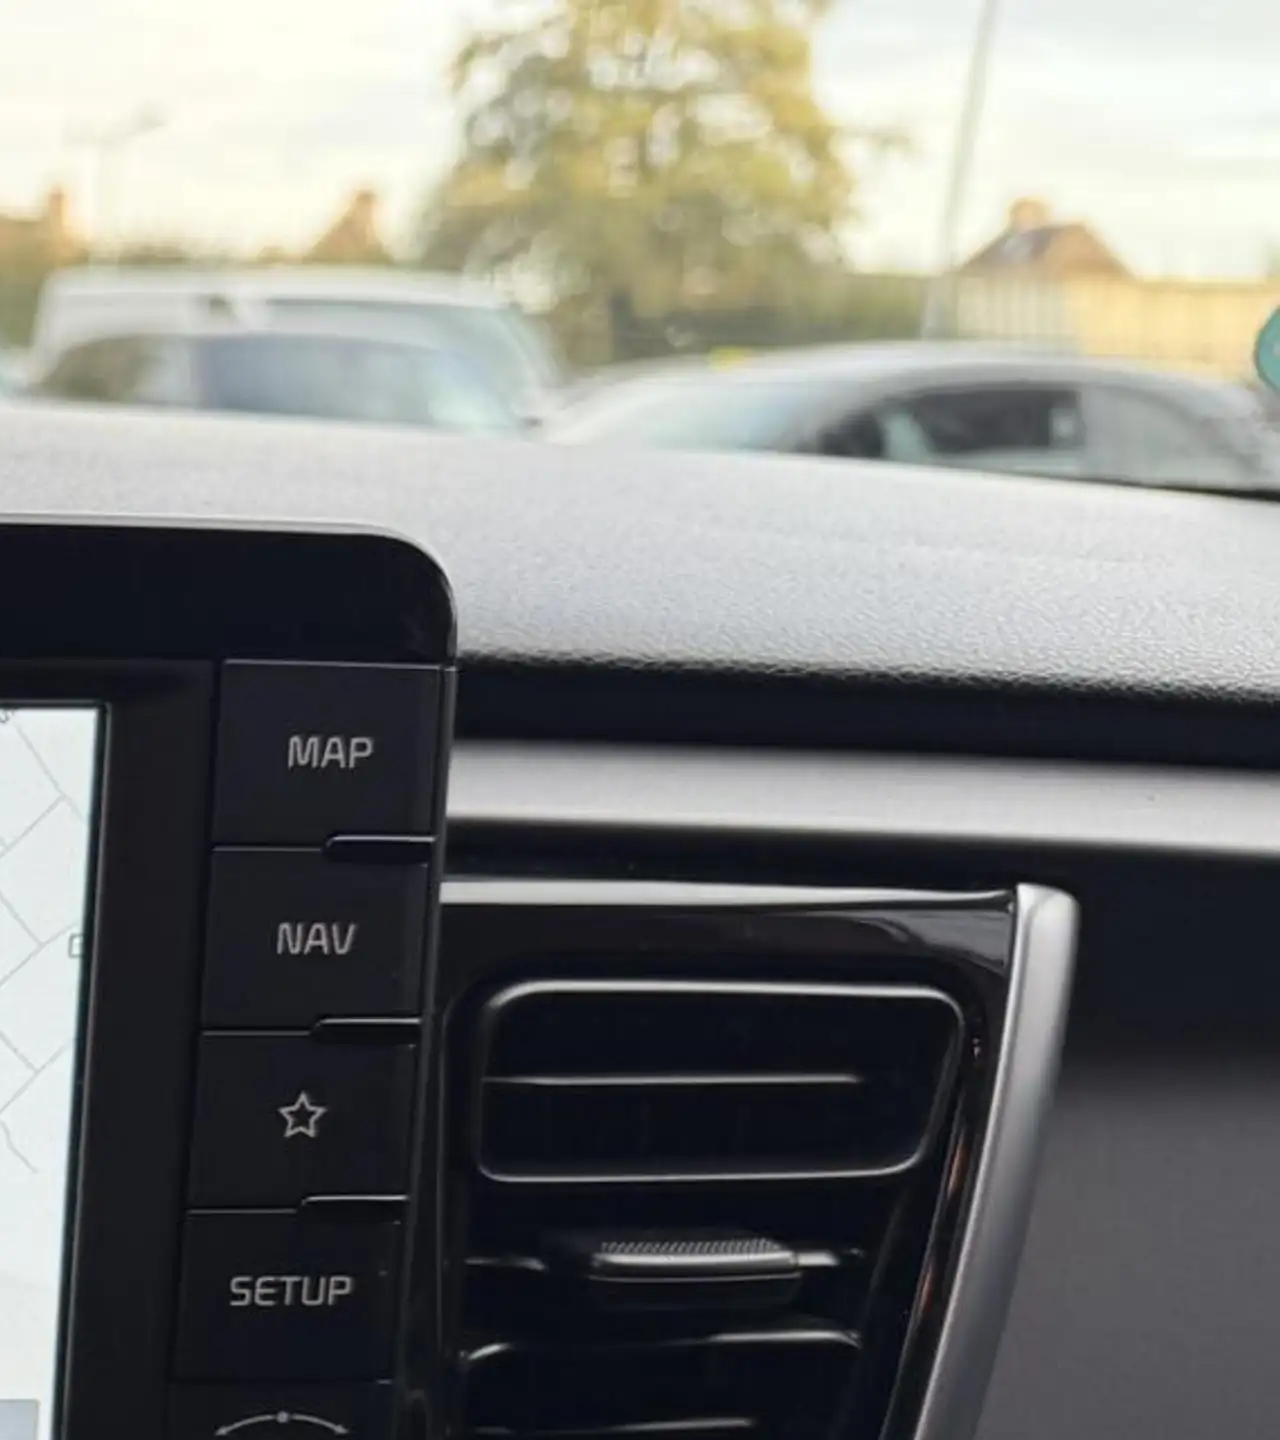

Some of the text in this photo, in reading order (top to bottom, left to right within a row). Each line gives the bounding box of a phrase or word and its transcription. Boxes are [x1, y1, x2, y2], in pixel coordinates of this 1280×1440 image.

[286, 735, 375, 769] MAP
[276, 922, 358, 955] NAV
[229, 1275, 354, 1306] SETUP
